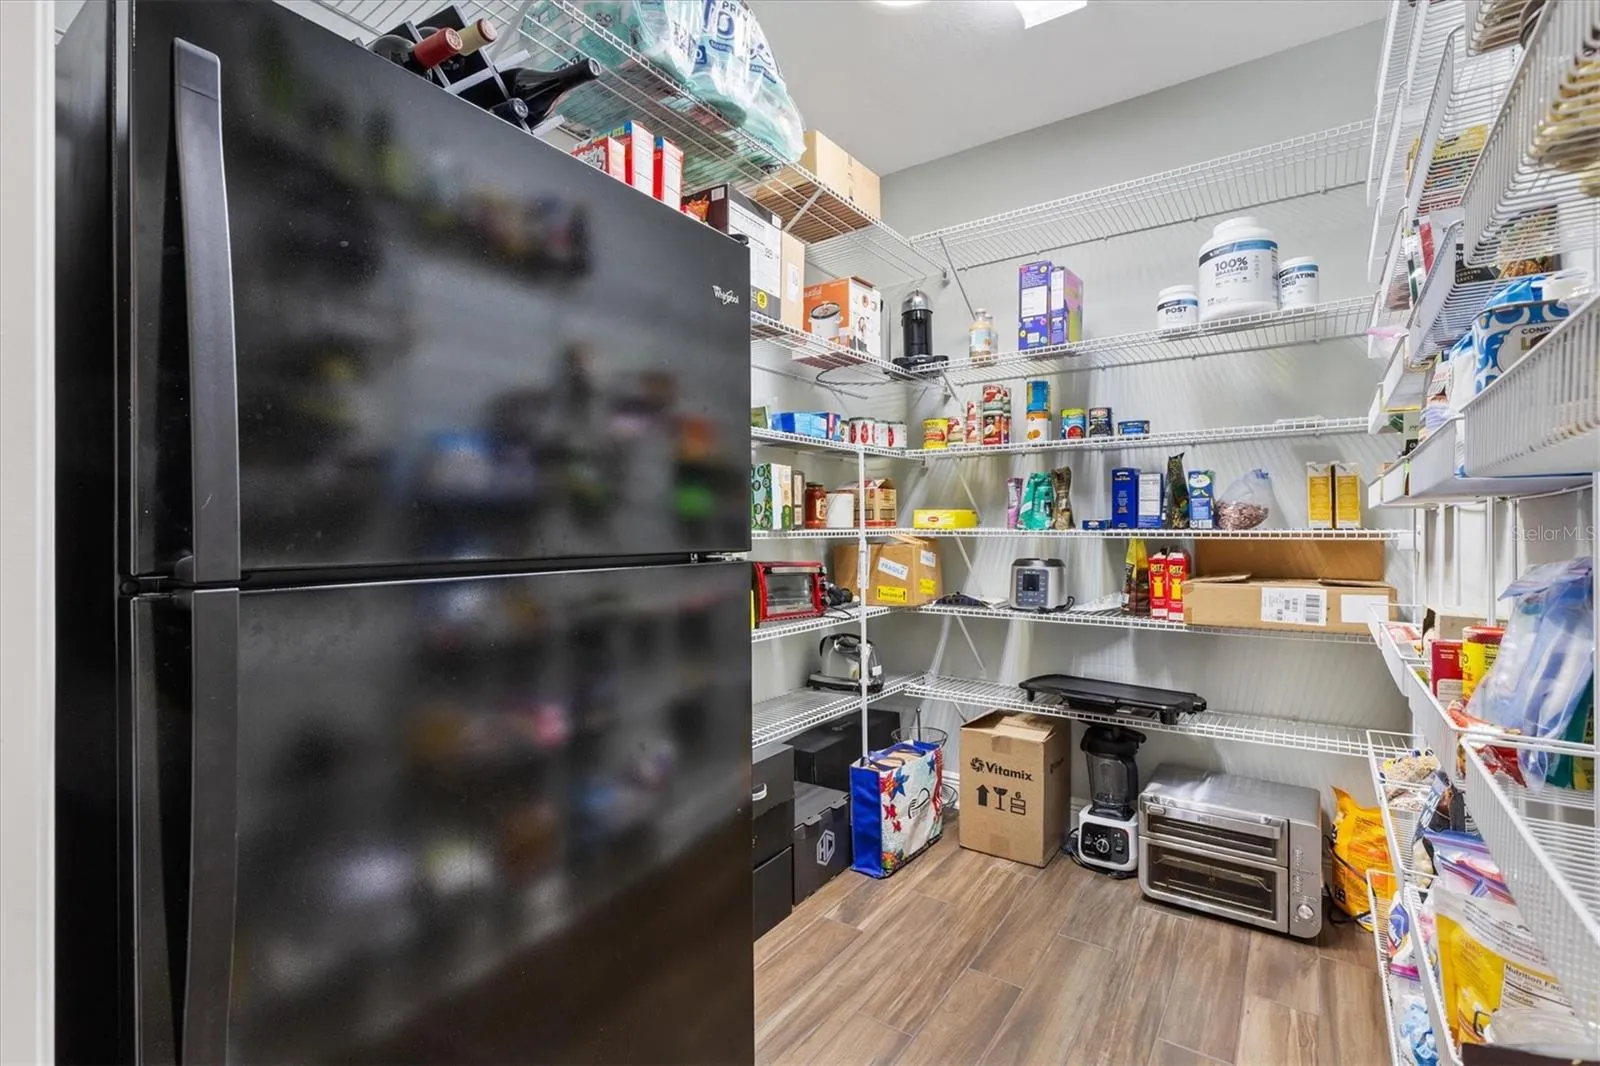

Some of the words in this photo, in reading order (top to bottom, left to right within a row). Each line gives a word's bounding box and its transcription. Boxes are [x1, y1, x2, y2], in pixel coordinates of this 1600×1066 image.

[1214, 255, 1249, 272] 100%
[1165, 306, 1187, 315] POST
[1150, 563, 1165, 572] RITZ
[1169, 564, 1184, 574] RITZ
[985, 762, 1033, 781] Vitamix
[1505, 963, 1542, 985] Nutrition
